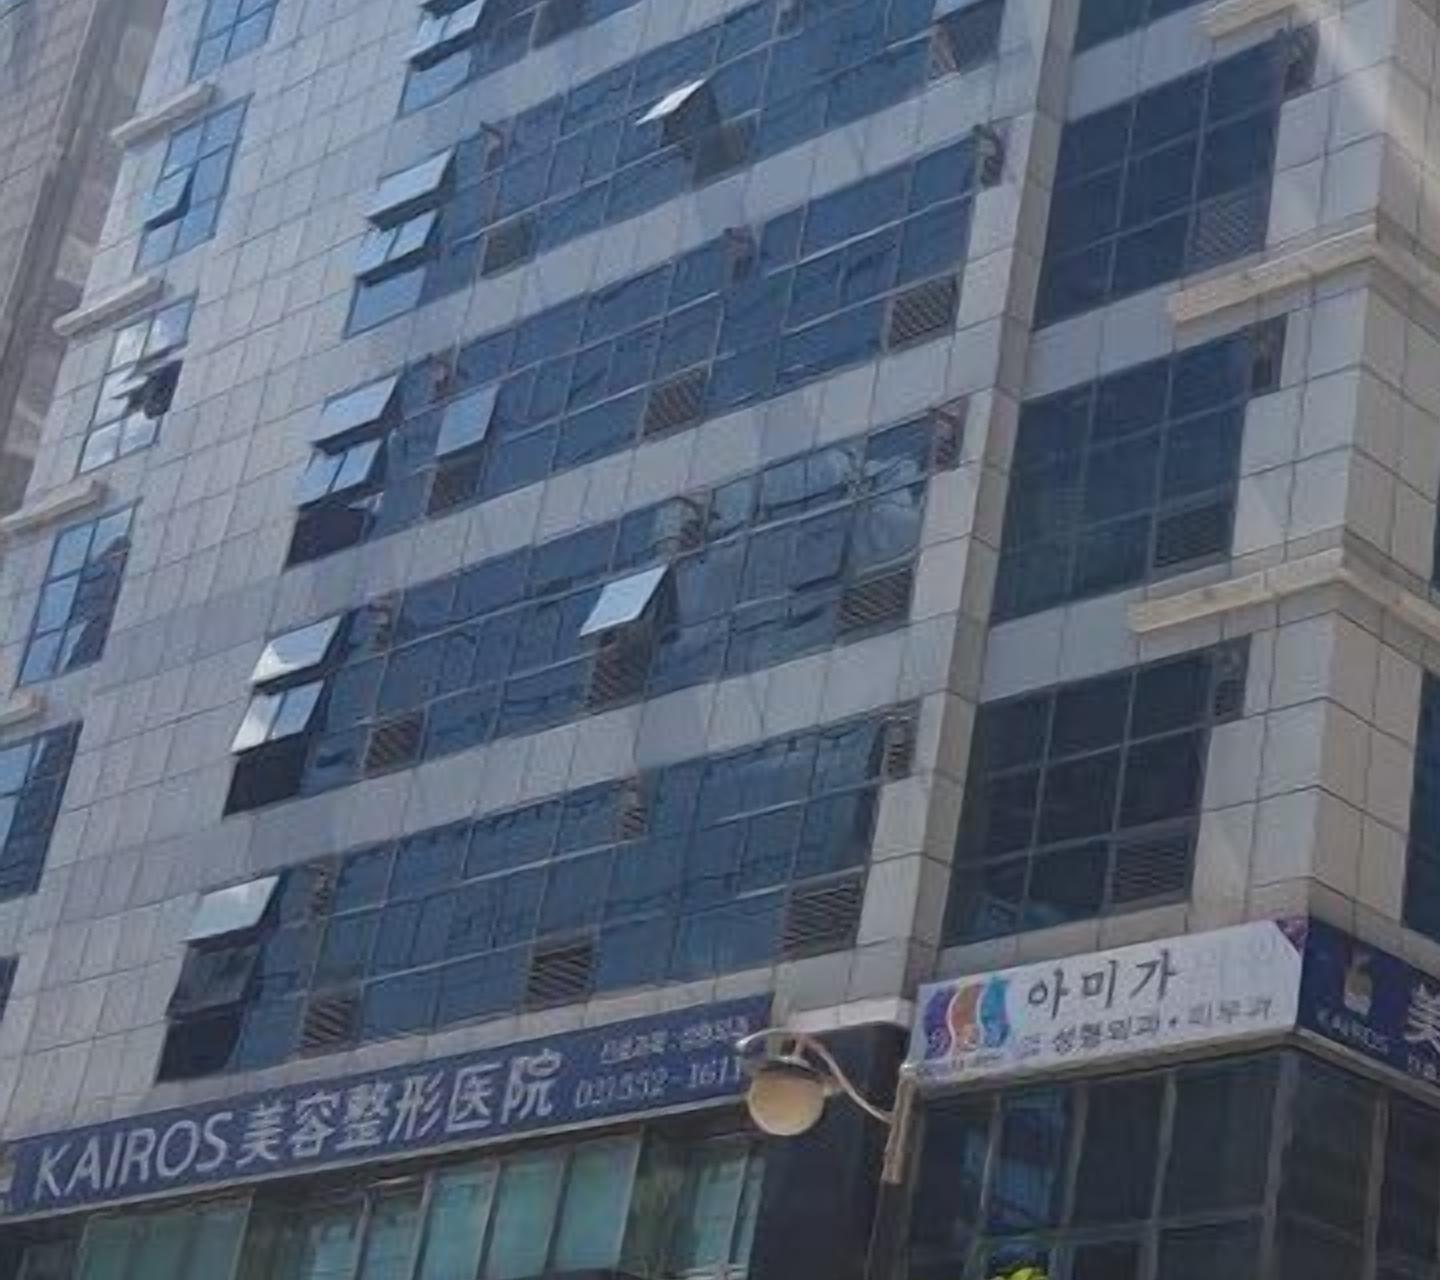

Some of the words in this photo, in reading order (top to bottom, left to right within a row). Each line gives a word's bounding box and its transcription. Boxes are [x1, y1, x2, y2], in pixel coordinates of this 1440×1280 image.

[1026, 948, 1178, 1019] 아미가
[32, 1111, 234, 1202] KAIROS
[235, 1048, 563, 1169] 美容整形医院
